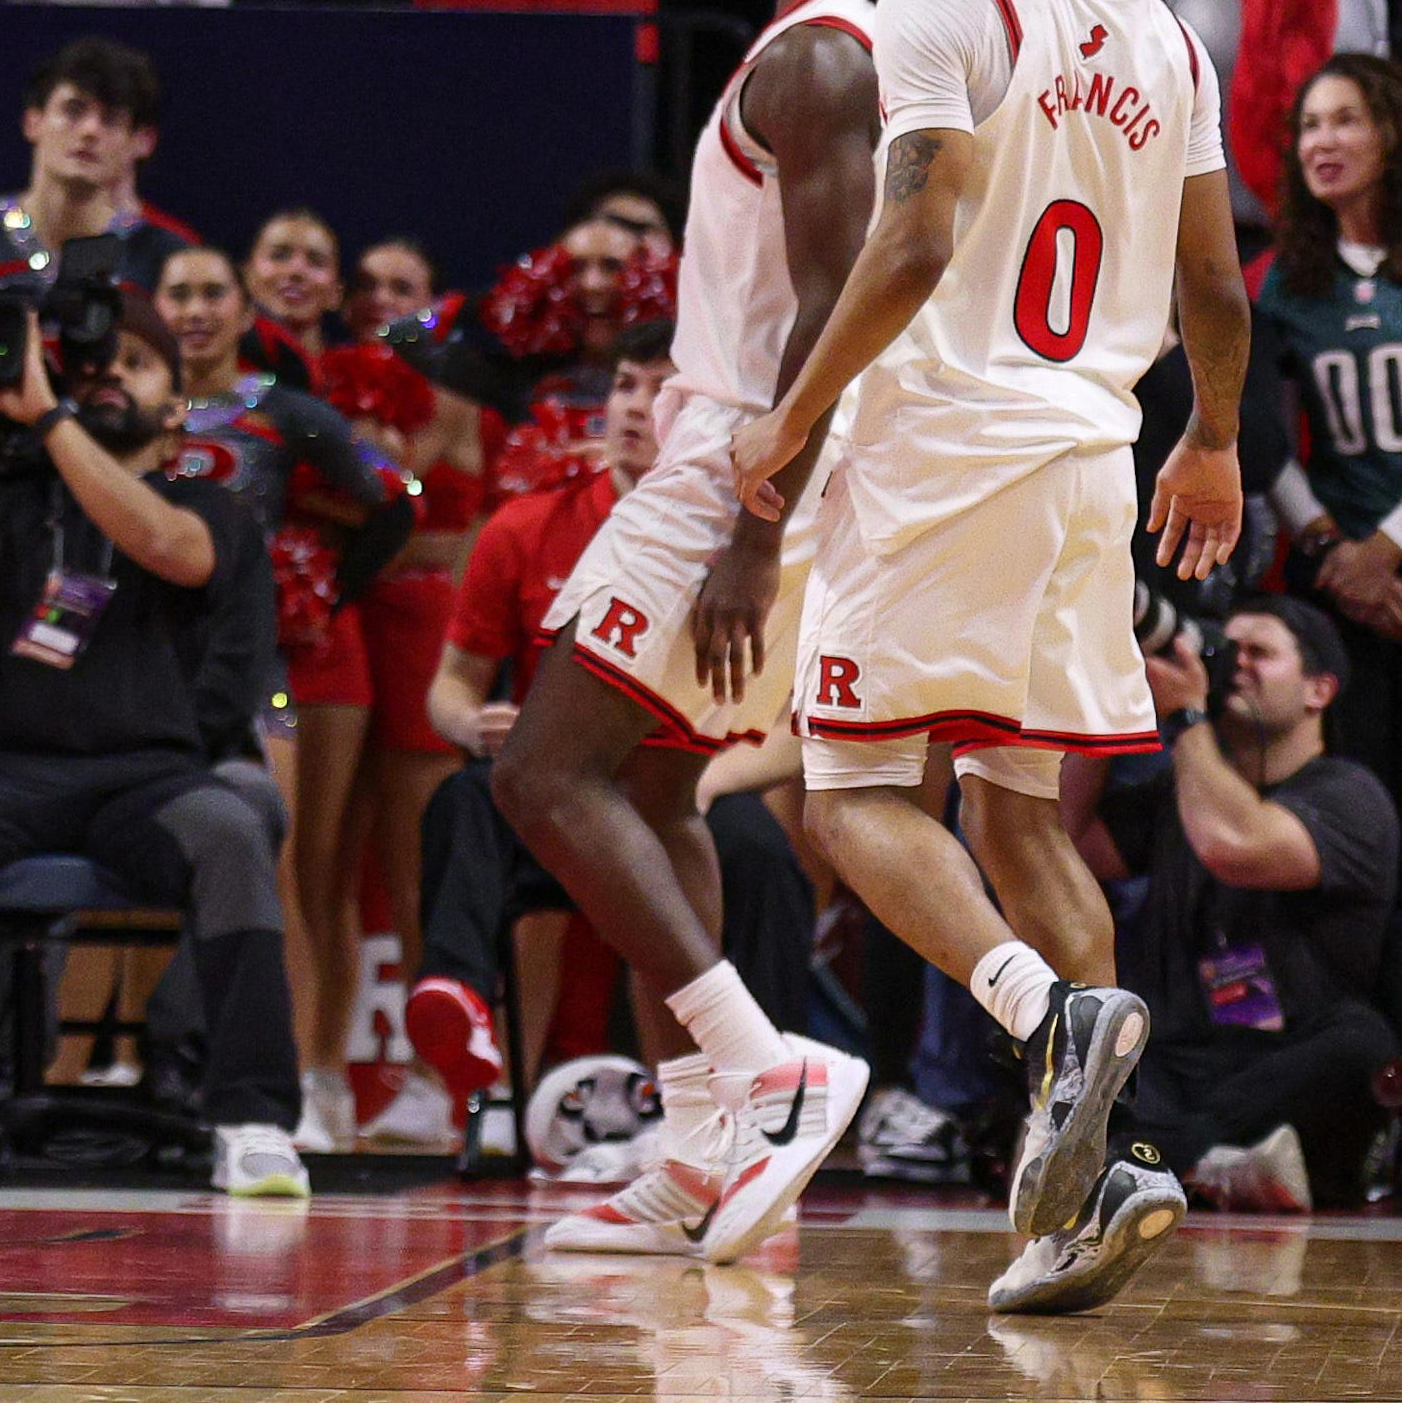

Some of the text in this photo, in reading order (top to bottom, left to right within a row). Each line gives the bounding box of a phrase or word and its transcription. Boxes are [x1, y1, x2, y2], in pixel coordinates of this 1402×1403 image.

[1037, 72, 1160, 151] FRANCIS
[1013, 198, 1103, 363] 0
[591, 596, 649, 658] R
[816, 654, 861, 709] R
